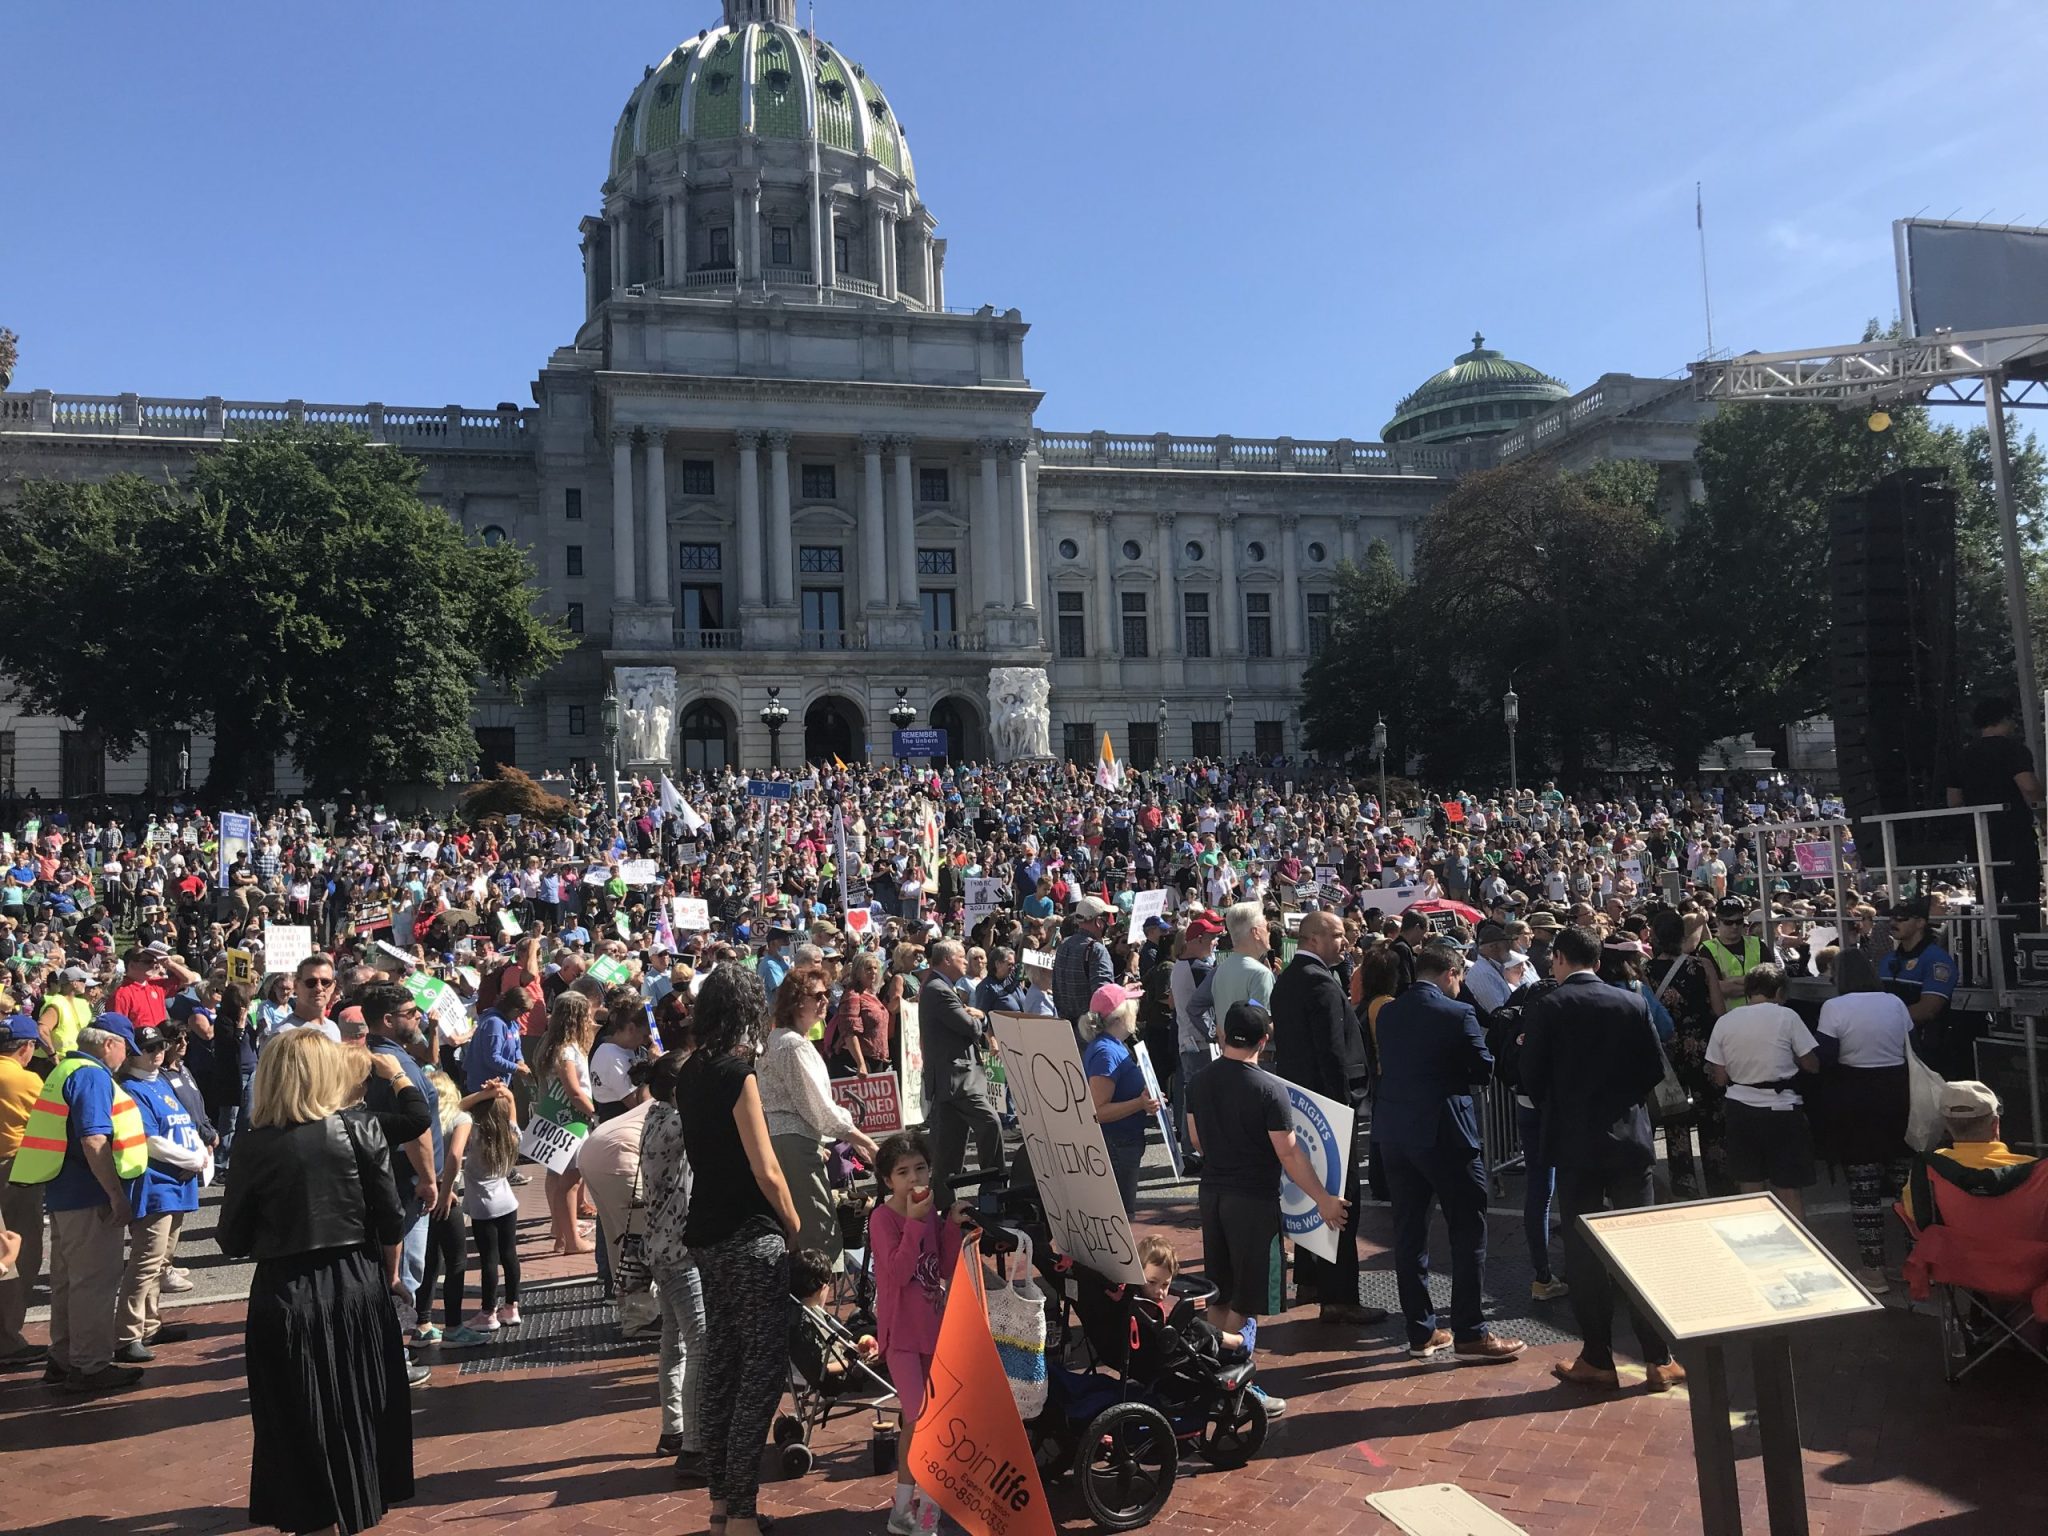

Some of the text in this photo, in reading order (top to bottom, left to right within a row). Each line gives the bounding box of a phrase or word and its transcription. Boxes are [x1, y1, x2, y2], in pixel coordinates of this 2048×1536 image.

[1037, 956, 1055, 969] LIFE
[832, 1080, 892, 1102] DEFUND
[1001, 1041, 1087, 1124] STOP
[1299, 1095, 1331, 1142] RIGHTS
[532, 1119, 575, 1152] CHOOSE
[531, 1141, 556, 1165] LIFE
[1286, 1217, 1302, 1232] the
[1597, 1220, 1616, 1230] Old
[937, 1418, 1031, 1512] Spinlife
[919, 1450, 1009, 1536] 1-800-850-0335
